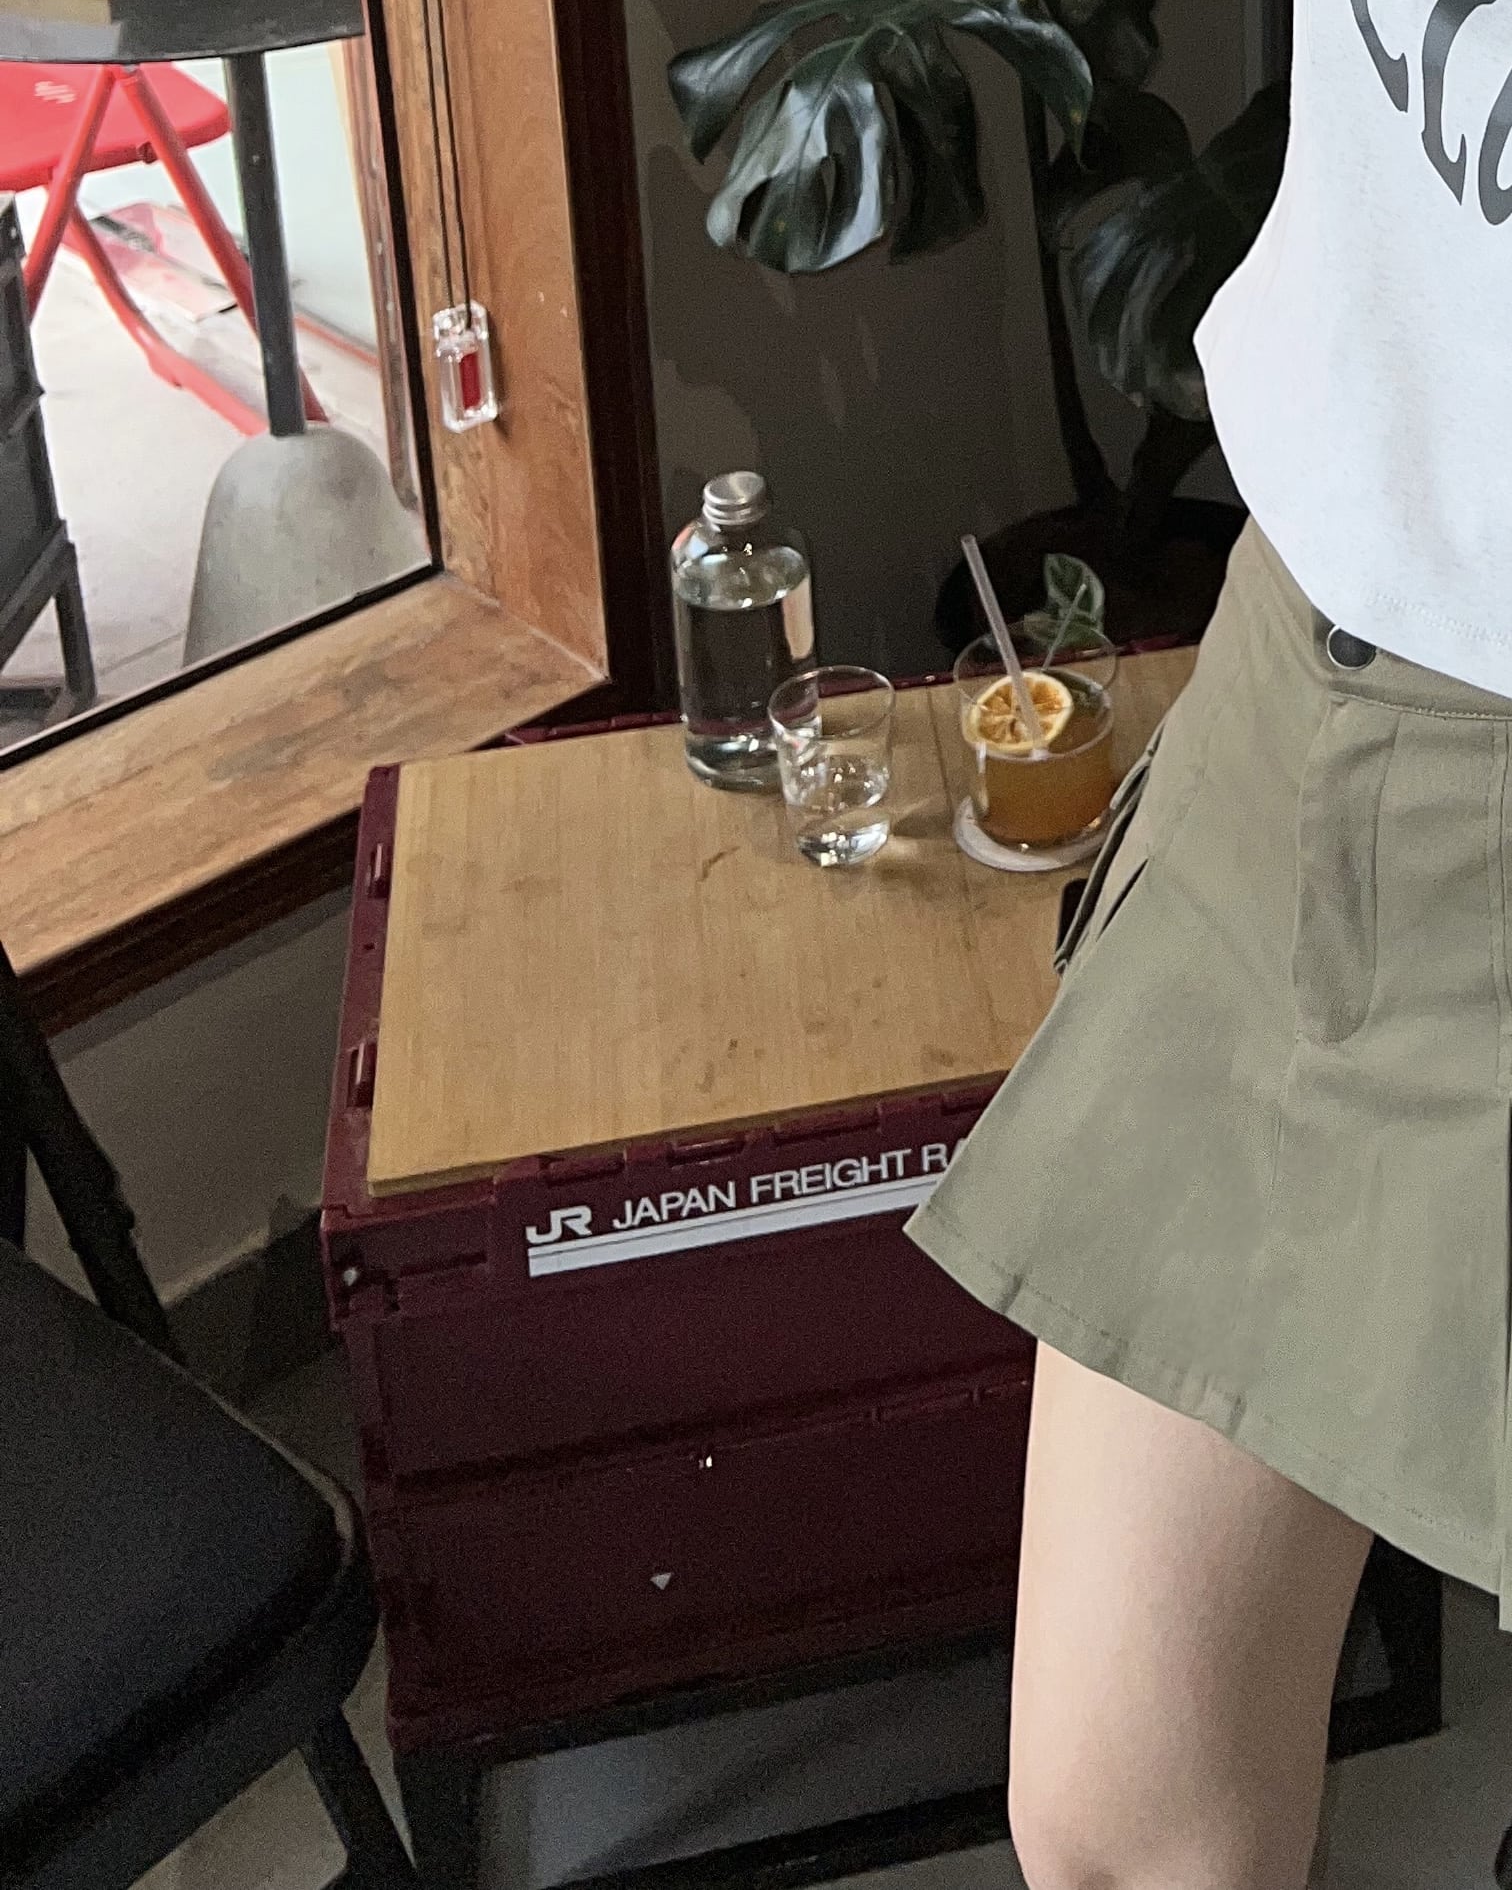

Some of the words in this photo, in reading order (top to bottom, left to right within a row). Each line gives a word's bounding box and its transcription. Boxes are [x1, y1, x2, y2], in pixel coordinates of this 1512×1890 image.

[525, 1204, 592, 1245] JR
[612, 1181, 737, 1230] JAPAN
[750, 1148, 912, 1205] FREIGHT
